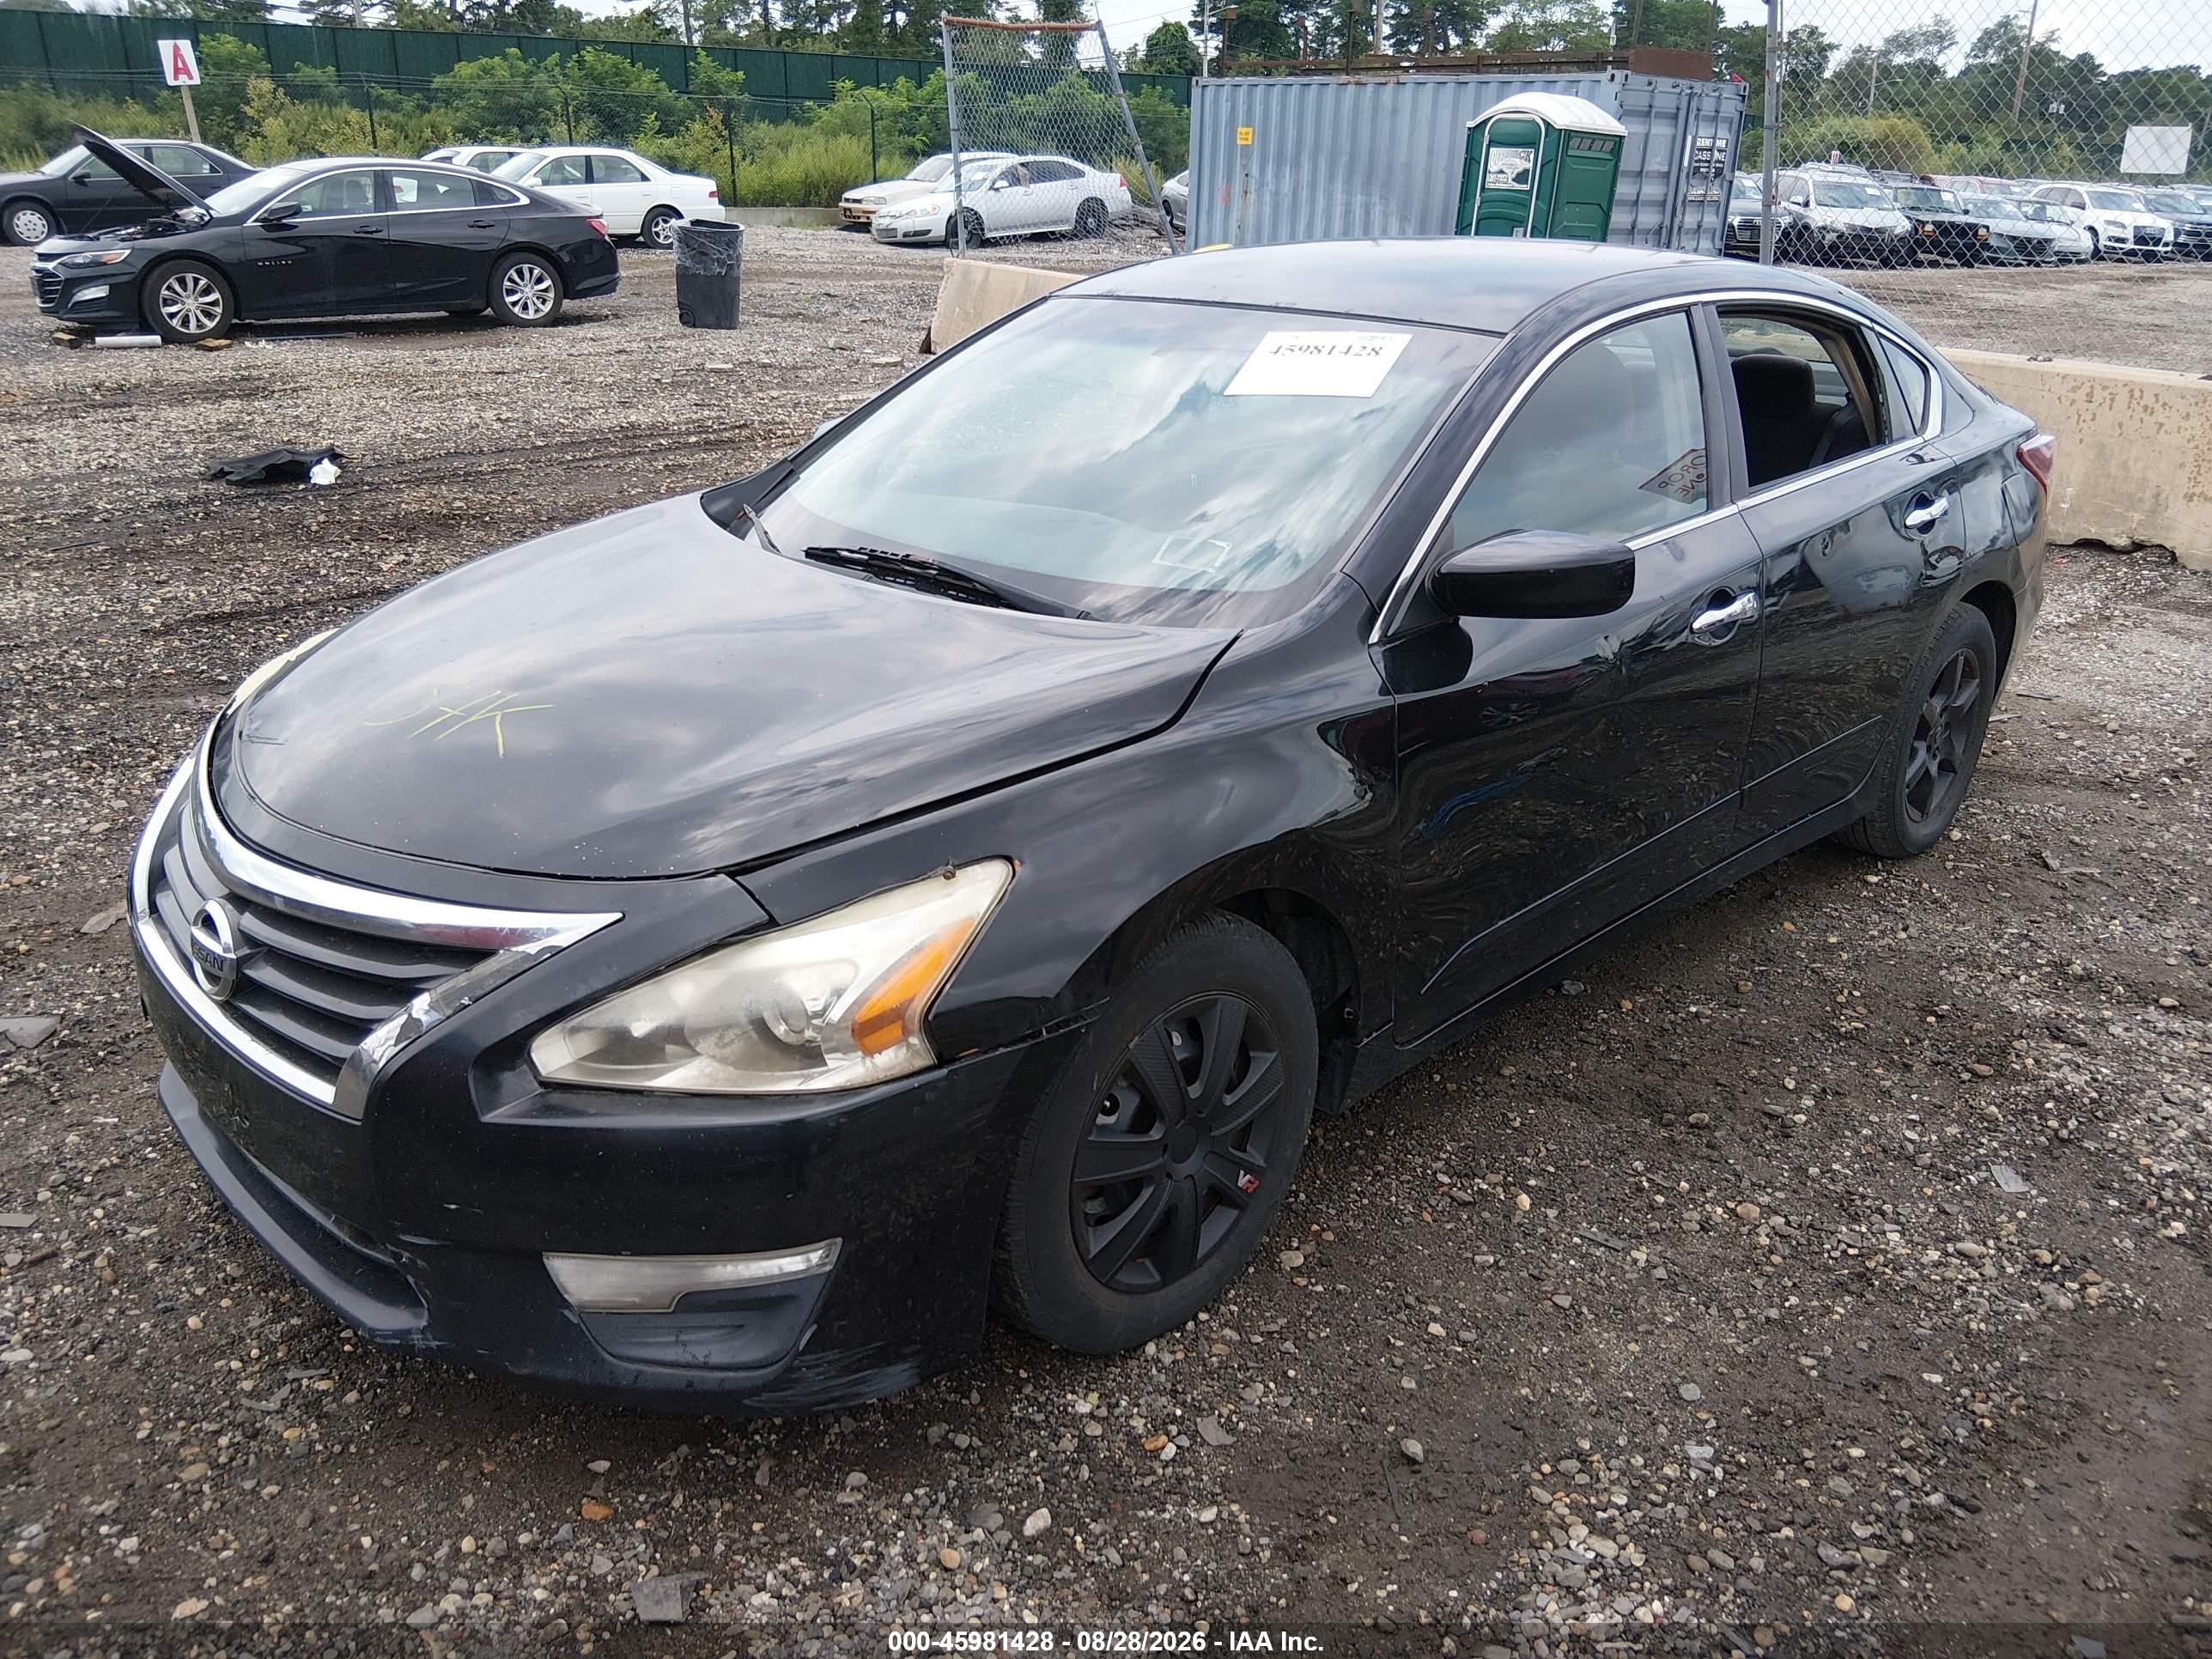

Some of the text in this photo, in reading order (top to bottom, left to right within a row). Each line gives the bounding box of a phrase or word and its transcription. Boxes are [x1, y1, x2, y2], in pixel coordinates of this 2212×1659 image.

[173, 41, 194, 82] A
[1696, 137, 1727, 148] RENT ME
[1693, 149, 1726, 161] CASSNE
[1269, 344, 1383, 357] 45981428
